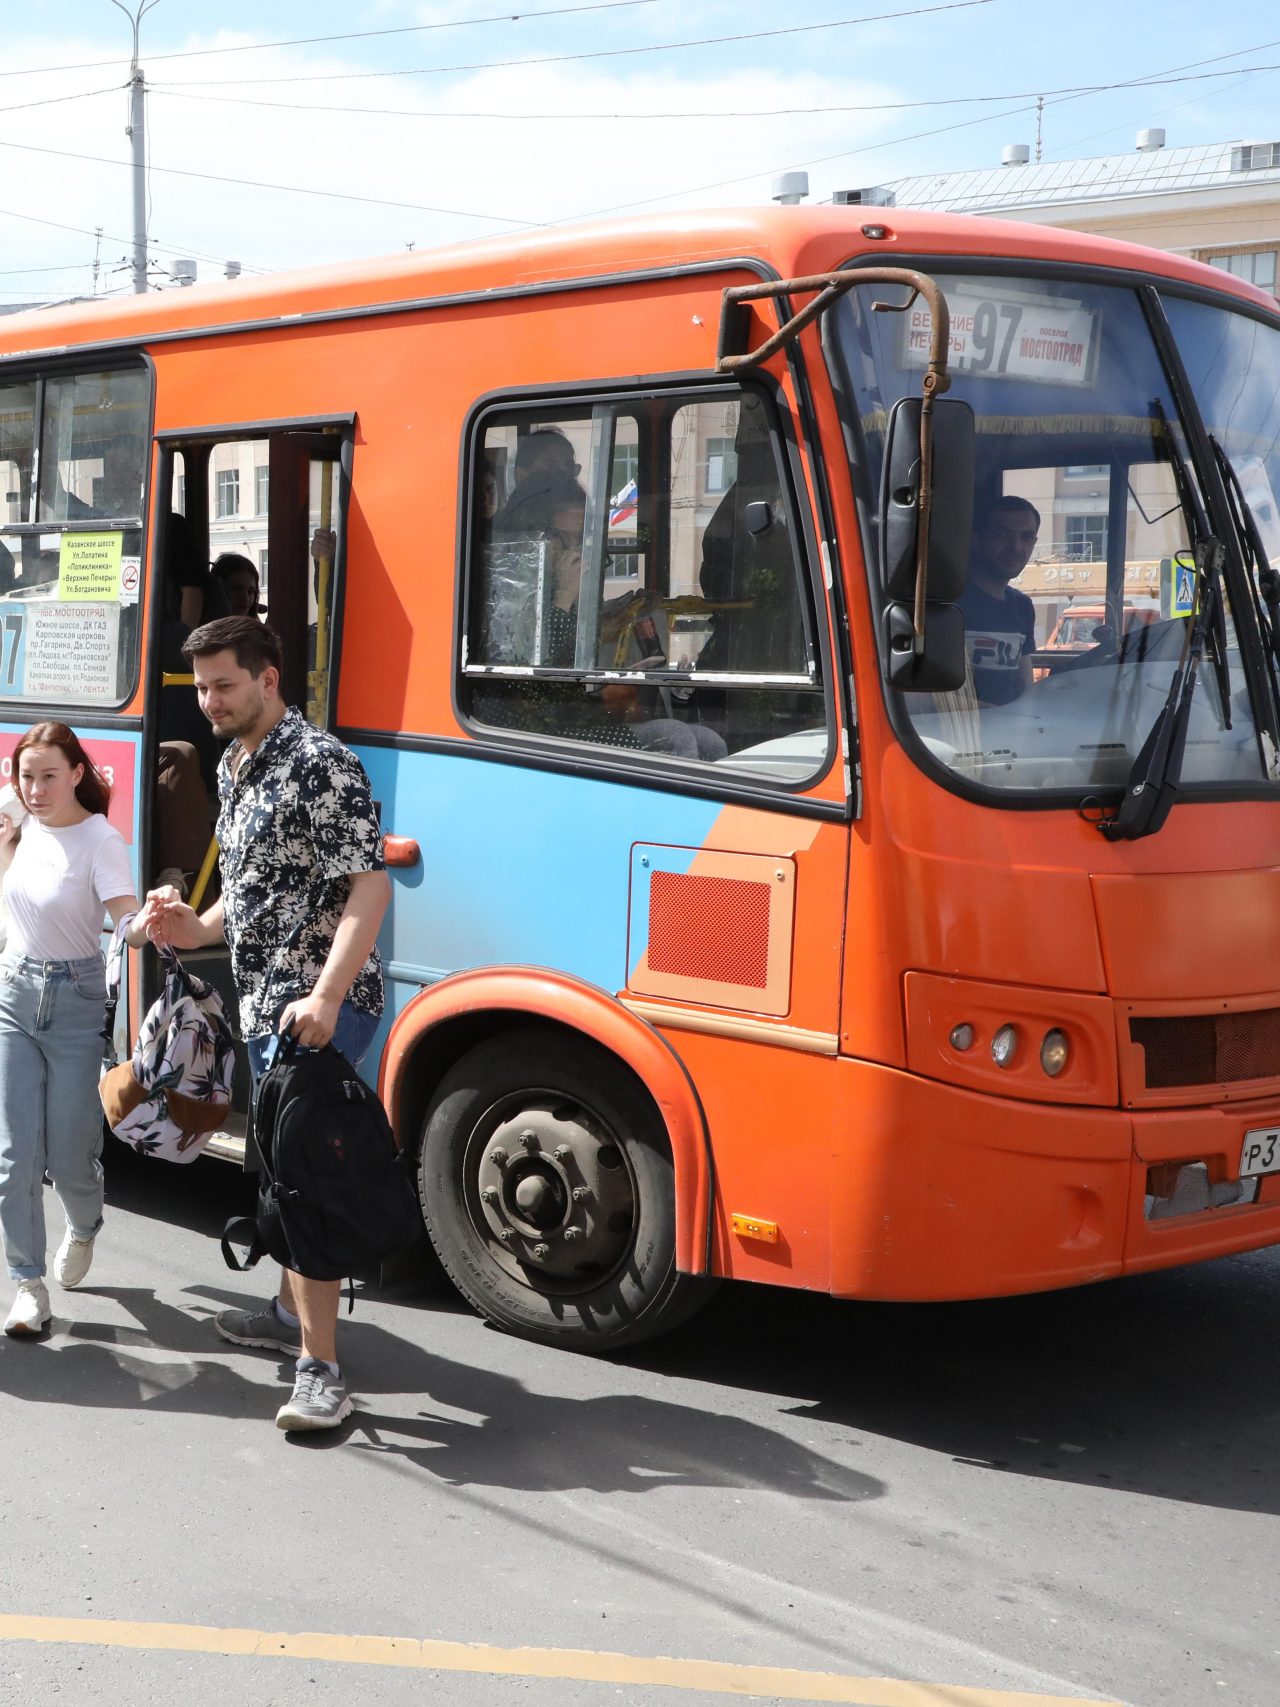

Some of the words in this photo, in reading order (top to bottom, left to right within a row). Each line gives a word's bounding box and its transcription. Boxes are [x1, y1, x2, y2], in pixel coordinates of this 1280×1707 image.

[912, 312, 974, 331] ВЕНИЕ
[972, 302, 1023, 373] 97
[1019, 336, 1082, 367] МОСТООТРЯД
[35, 620, 58, 629] Южное
[83, 621, 93, 631] ДК
[94, 621, 107, 630] ГАЗ
[35, 630, 76, 640] Карповская
[76, 631, 106, 641] церковь
[1247, 1134, 1280, 1171] Р3
